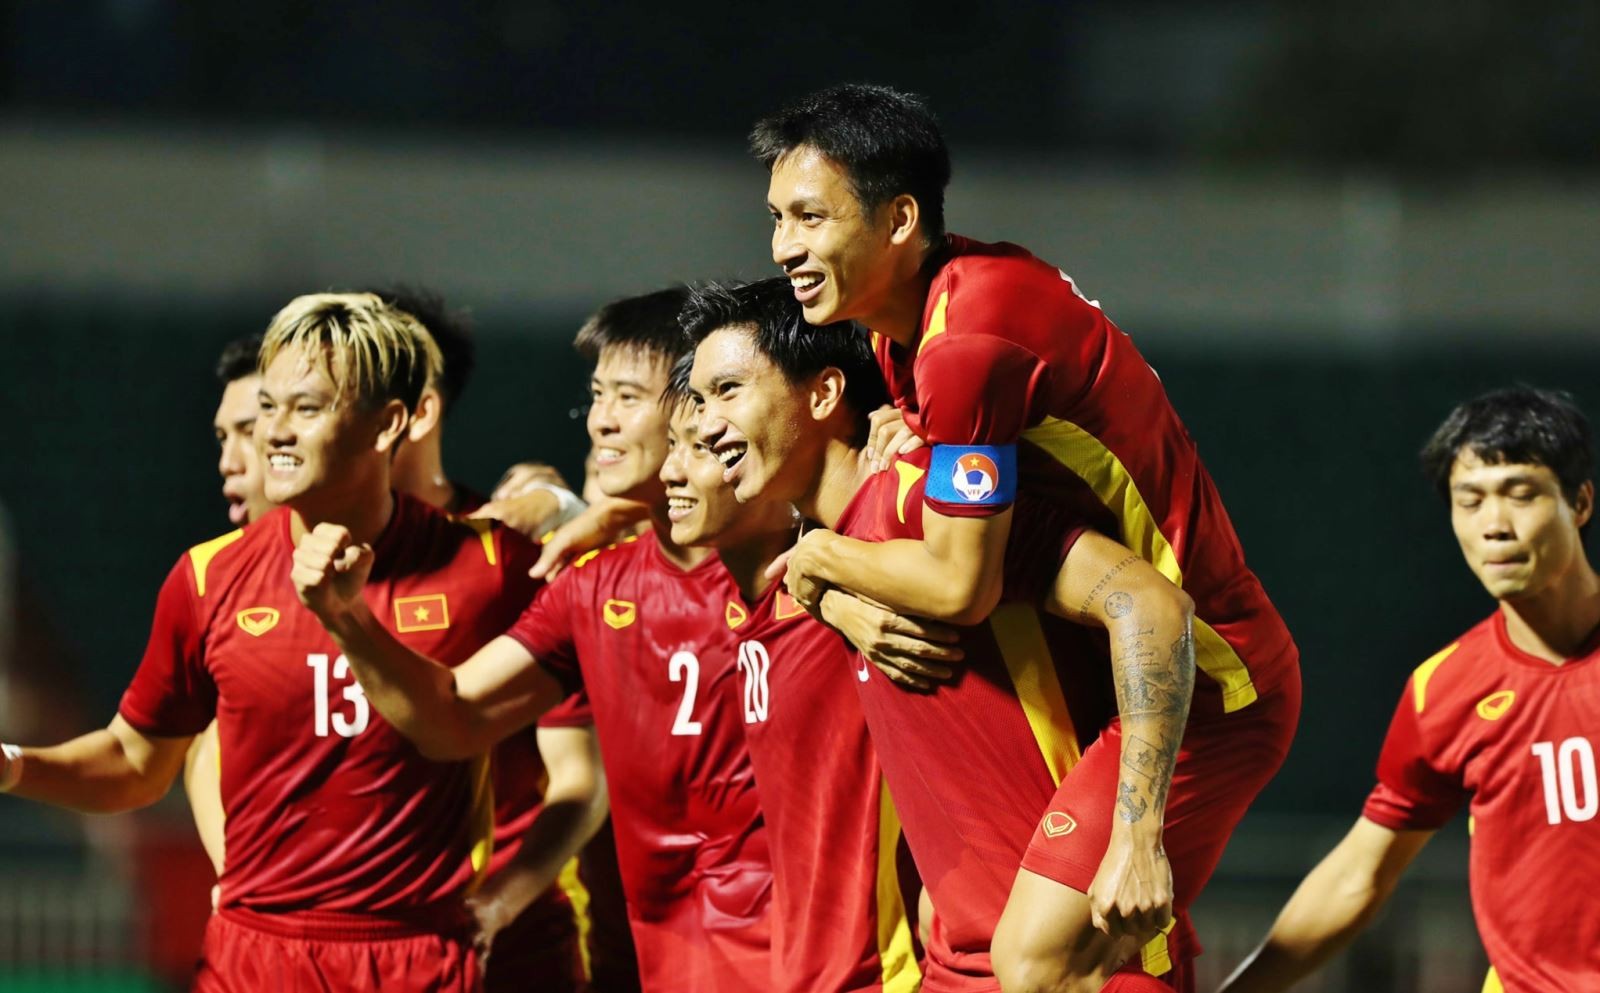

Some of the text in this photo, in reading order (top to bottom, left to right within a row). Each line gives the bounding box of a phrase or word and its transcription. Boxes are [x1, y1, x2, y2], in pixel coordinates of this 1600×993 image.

[306, 653, 370, 738] 13
[668, 650, 702, 736] 2
[738, 640, 770, 723] 20
[1531, 736, 1599, 825] 10
